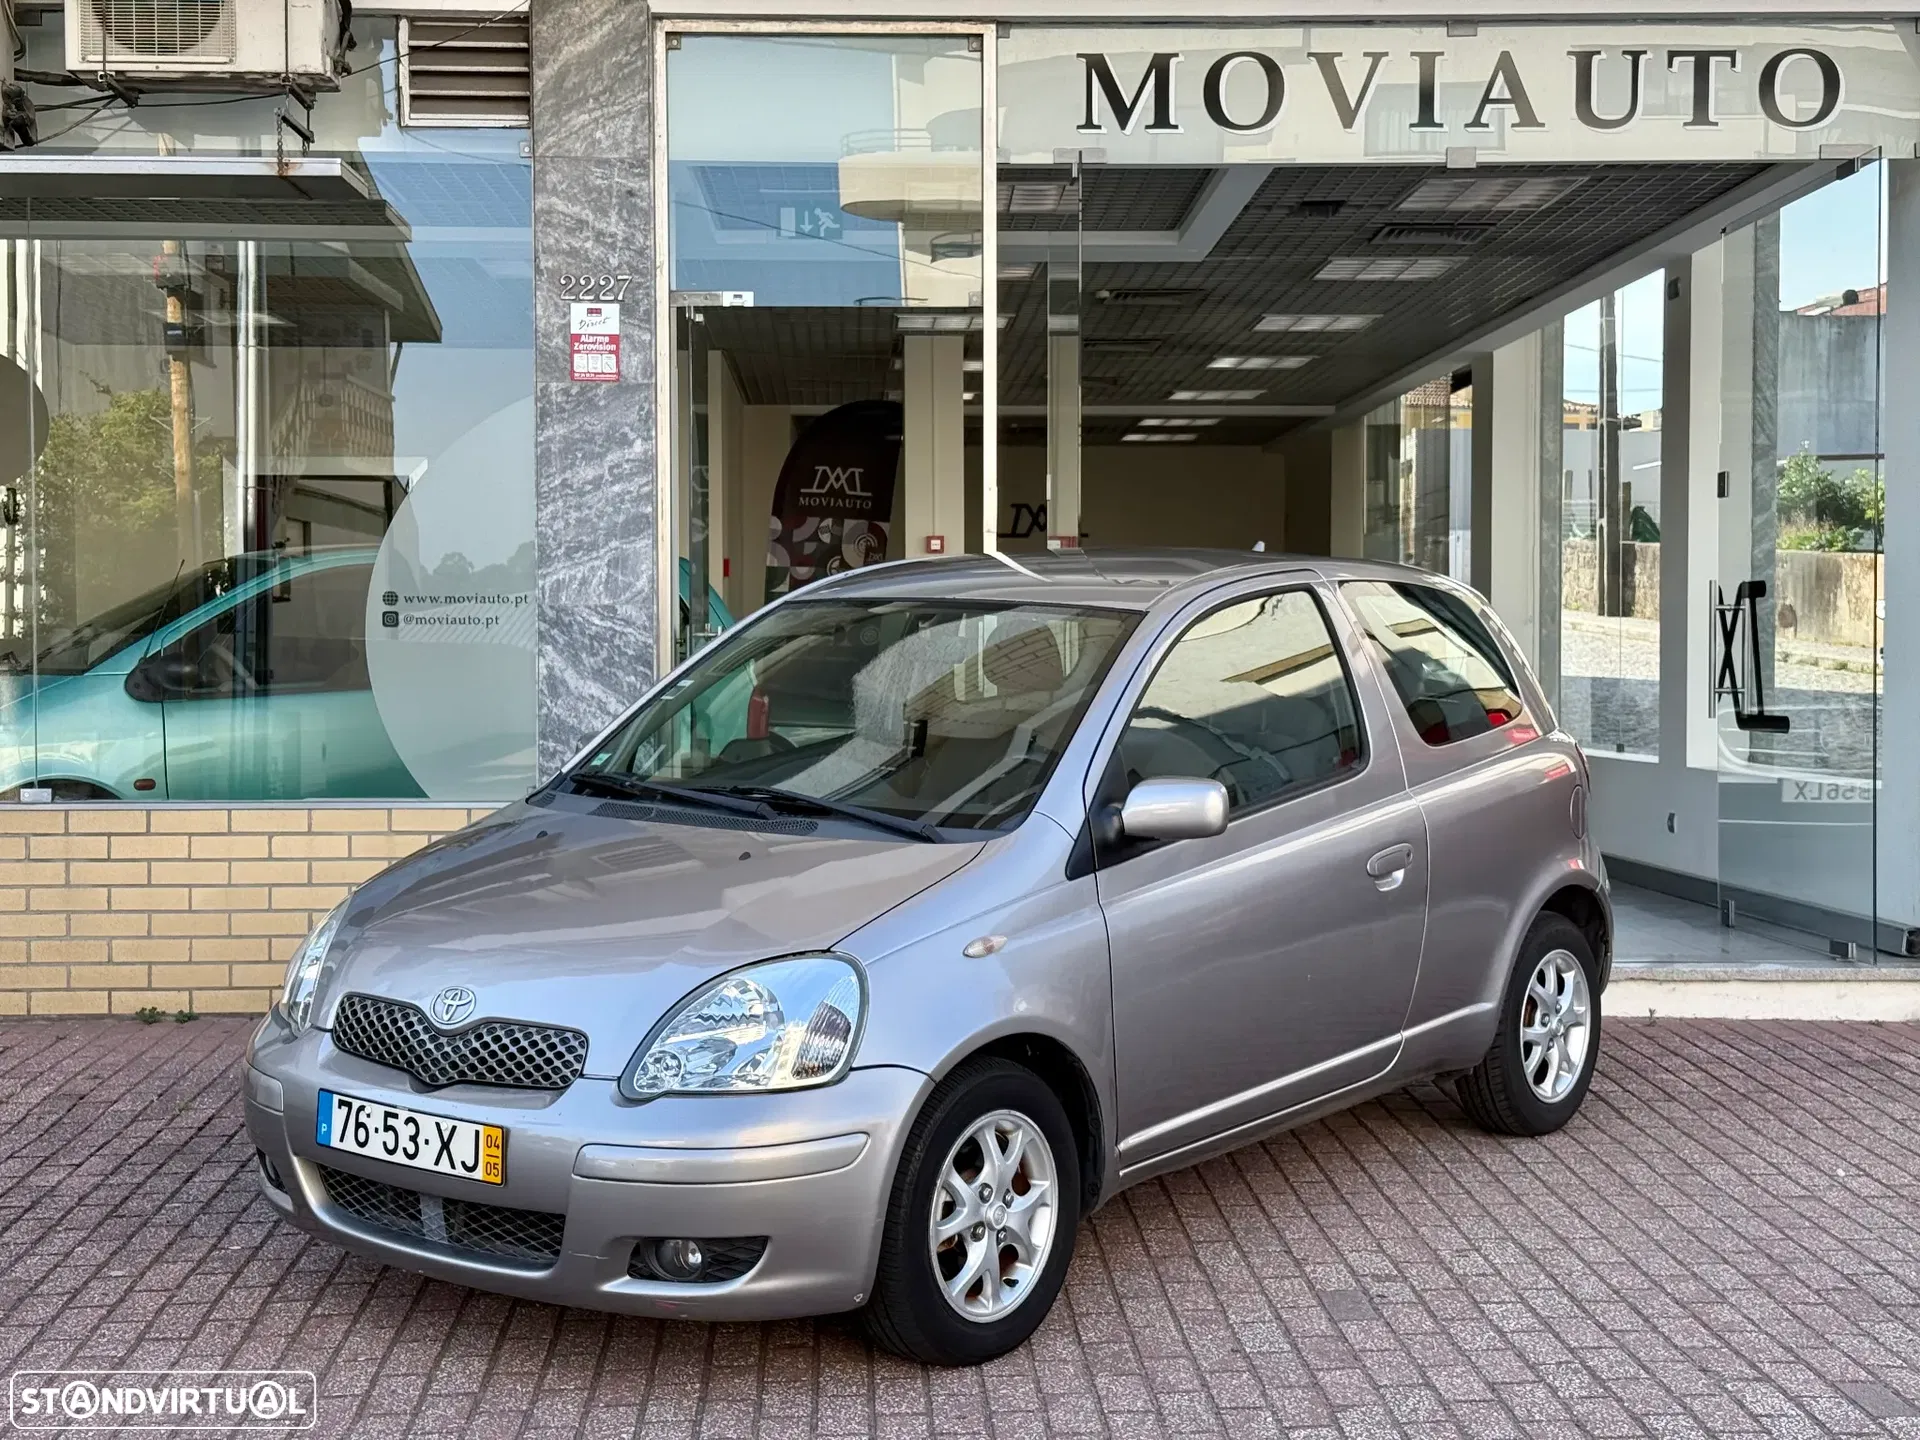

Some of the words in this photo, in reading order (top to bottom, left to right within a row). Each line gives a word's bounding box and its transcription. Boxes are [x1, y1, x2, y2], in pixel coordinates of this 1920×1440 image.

[1076, 47, 1846, 136] MOVIAUTO
[559, 274, 633, 301] 2227
[580, 334, 609, 343] Alarme
[573, 342, 616, 351] Zerovision
[798, 497, 873, 510] MOVIAUTO
[403, 592, 529, 608] www.moviauto.pt
[403, 613, 500, 629] @moviauto.pt
[320, 1123, 328, 1135] P
[486, 1134, 501, 1150] 04
[485, 1165, 501, 1178] 05
